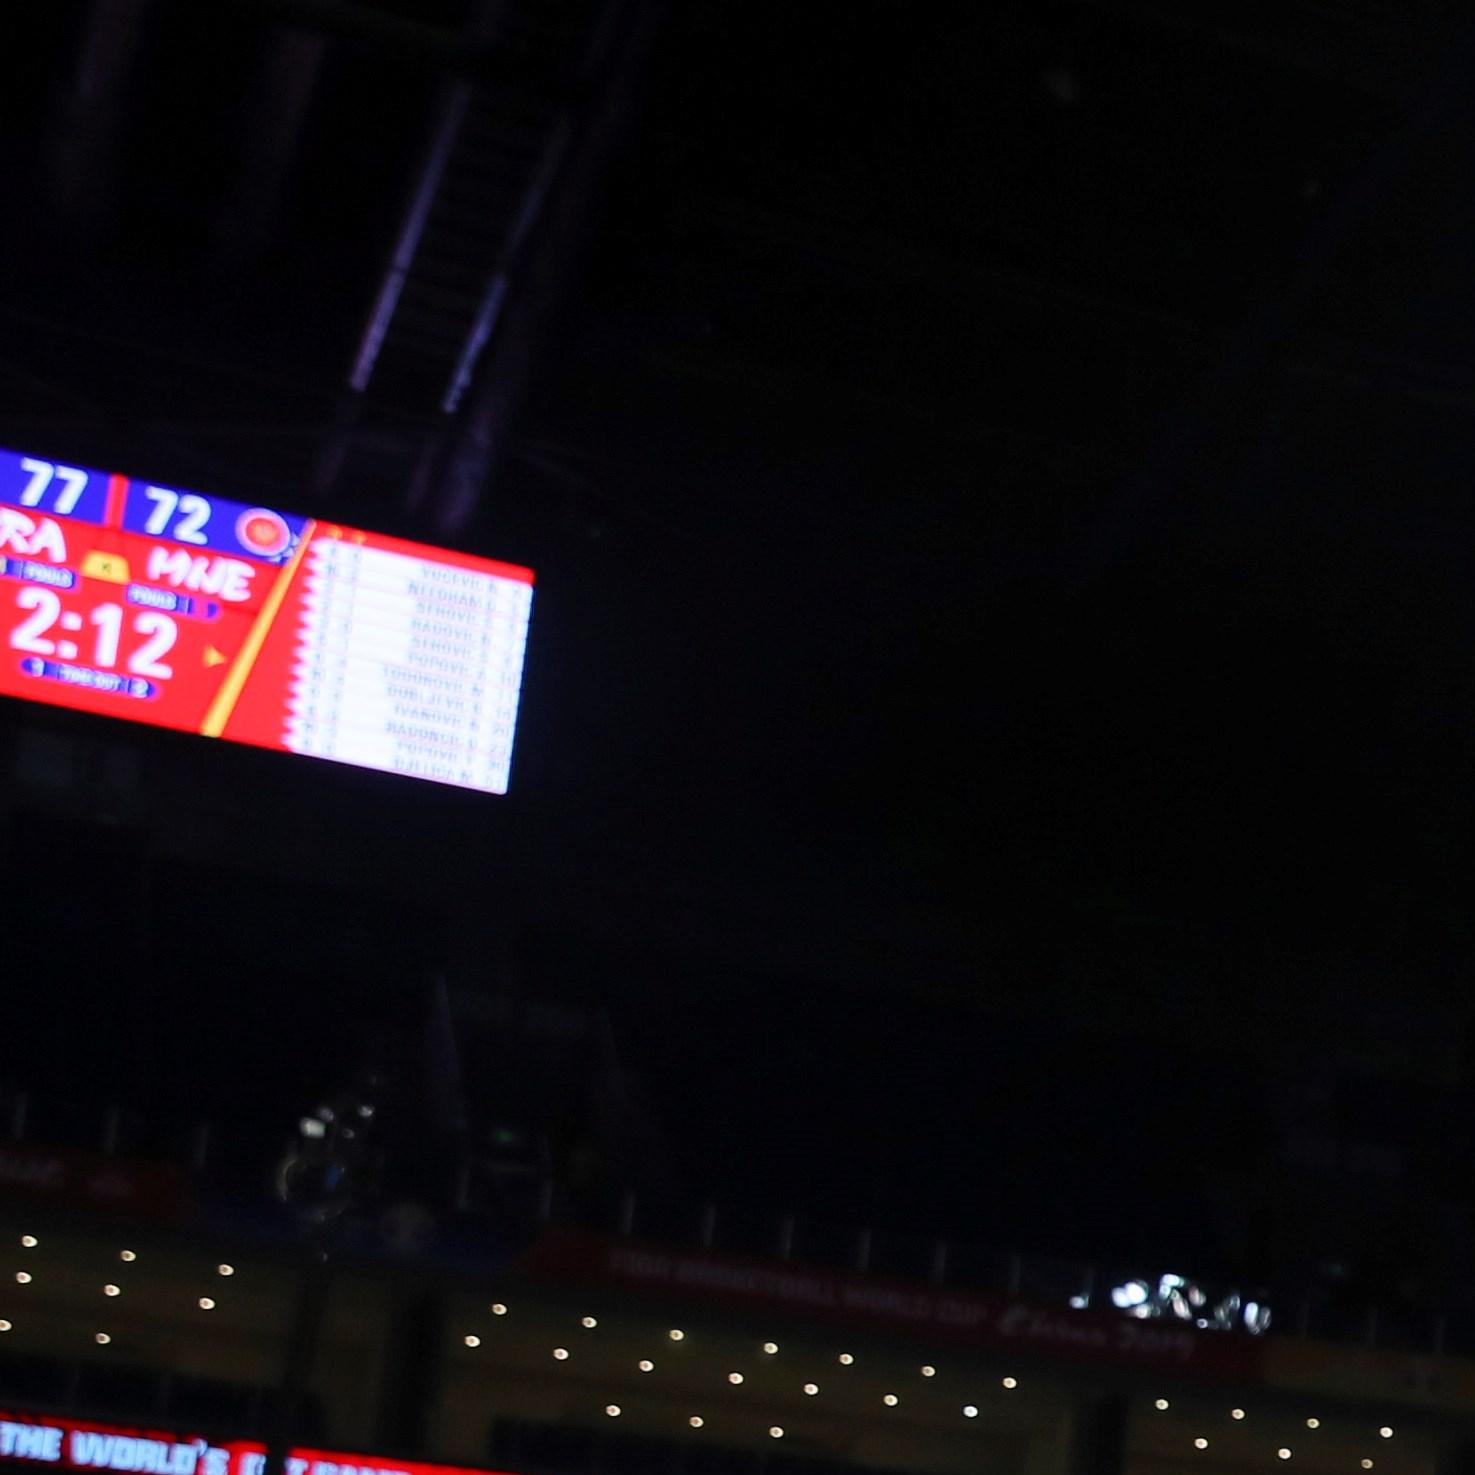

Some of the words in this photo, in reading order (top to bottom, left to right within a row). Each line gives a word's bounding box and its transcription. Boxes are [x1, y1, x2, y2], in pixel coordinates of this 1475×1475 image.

[20, 457, 88, 515] 77
[145, 486, 211, 545] 72
[9, 587, 178, 680] 2:12
[1, 1421, 62, 1460] THE
